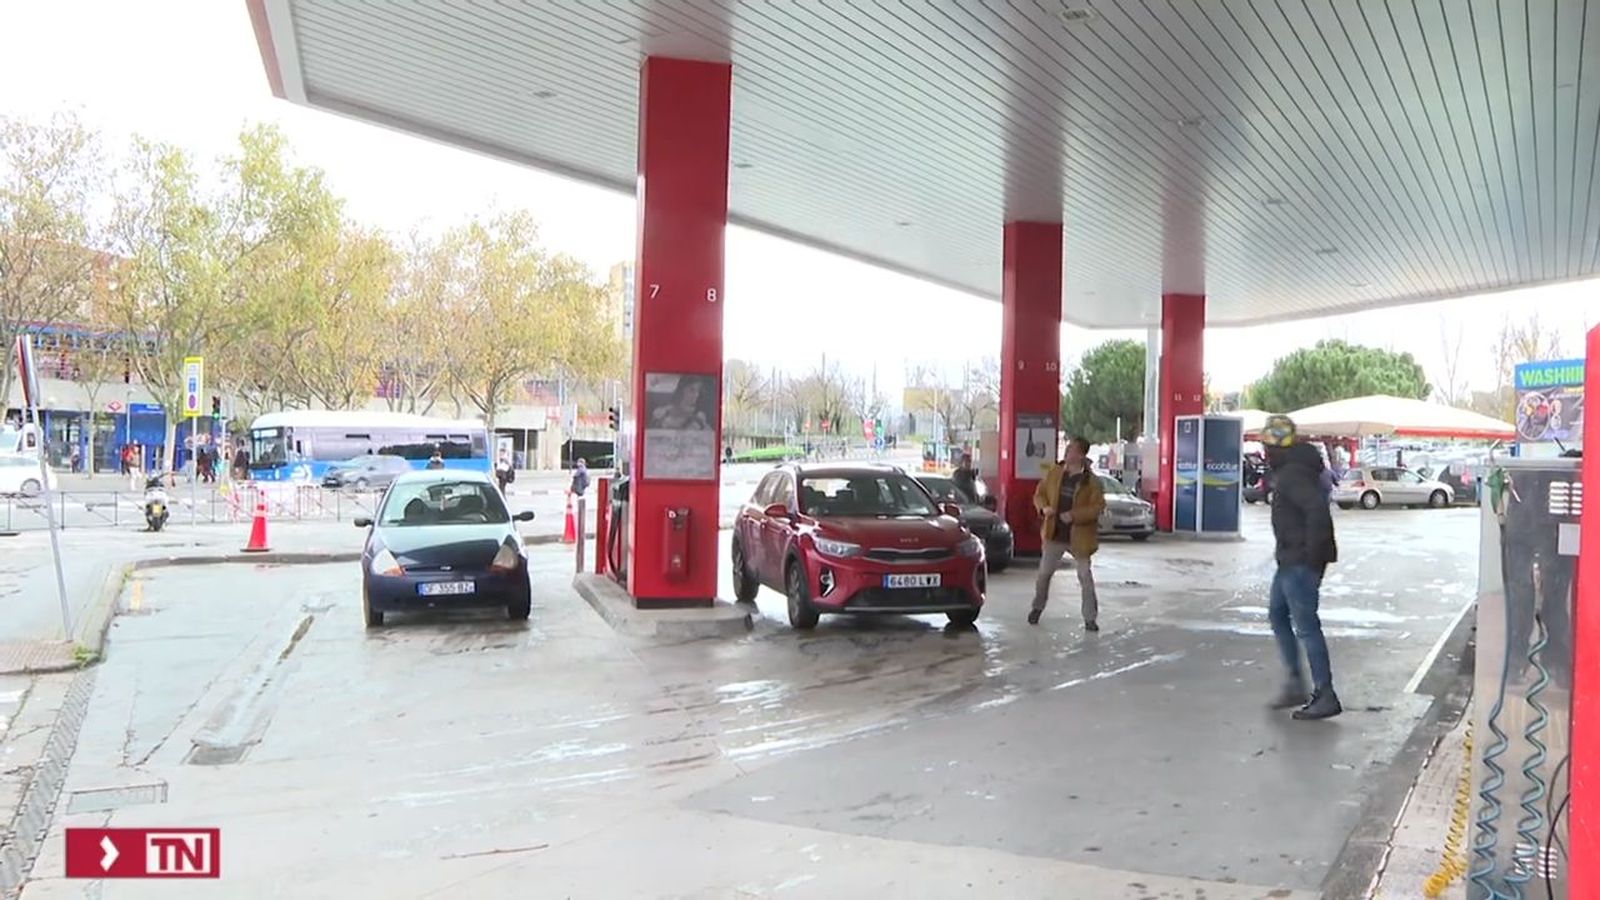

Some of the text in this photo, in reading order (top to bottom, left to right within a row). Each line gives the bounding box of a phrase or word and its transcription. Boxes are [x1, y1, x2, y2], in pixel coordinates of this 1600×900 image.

[649, 284, 660, 299] 7
[706, 288, 717, 302] 8
[1018, 360, 1025, 371] 9
[1045, 361, 1058, 372] 10
[1175, 393, 1182, 401] 11
[1193, 394, 1202, 402] 12
